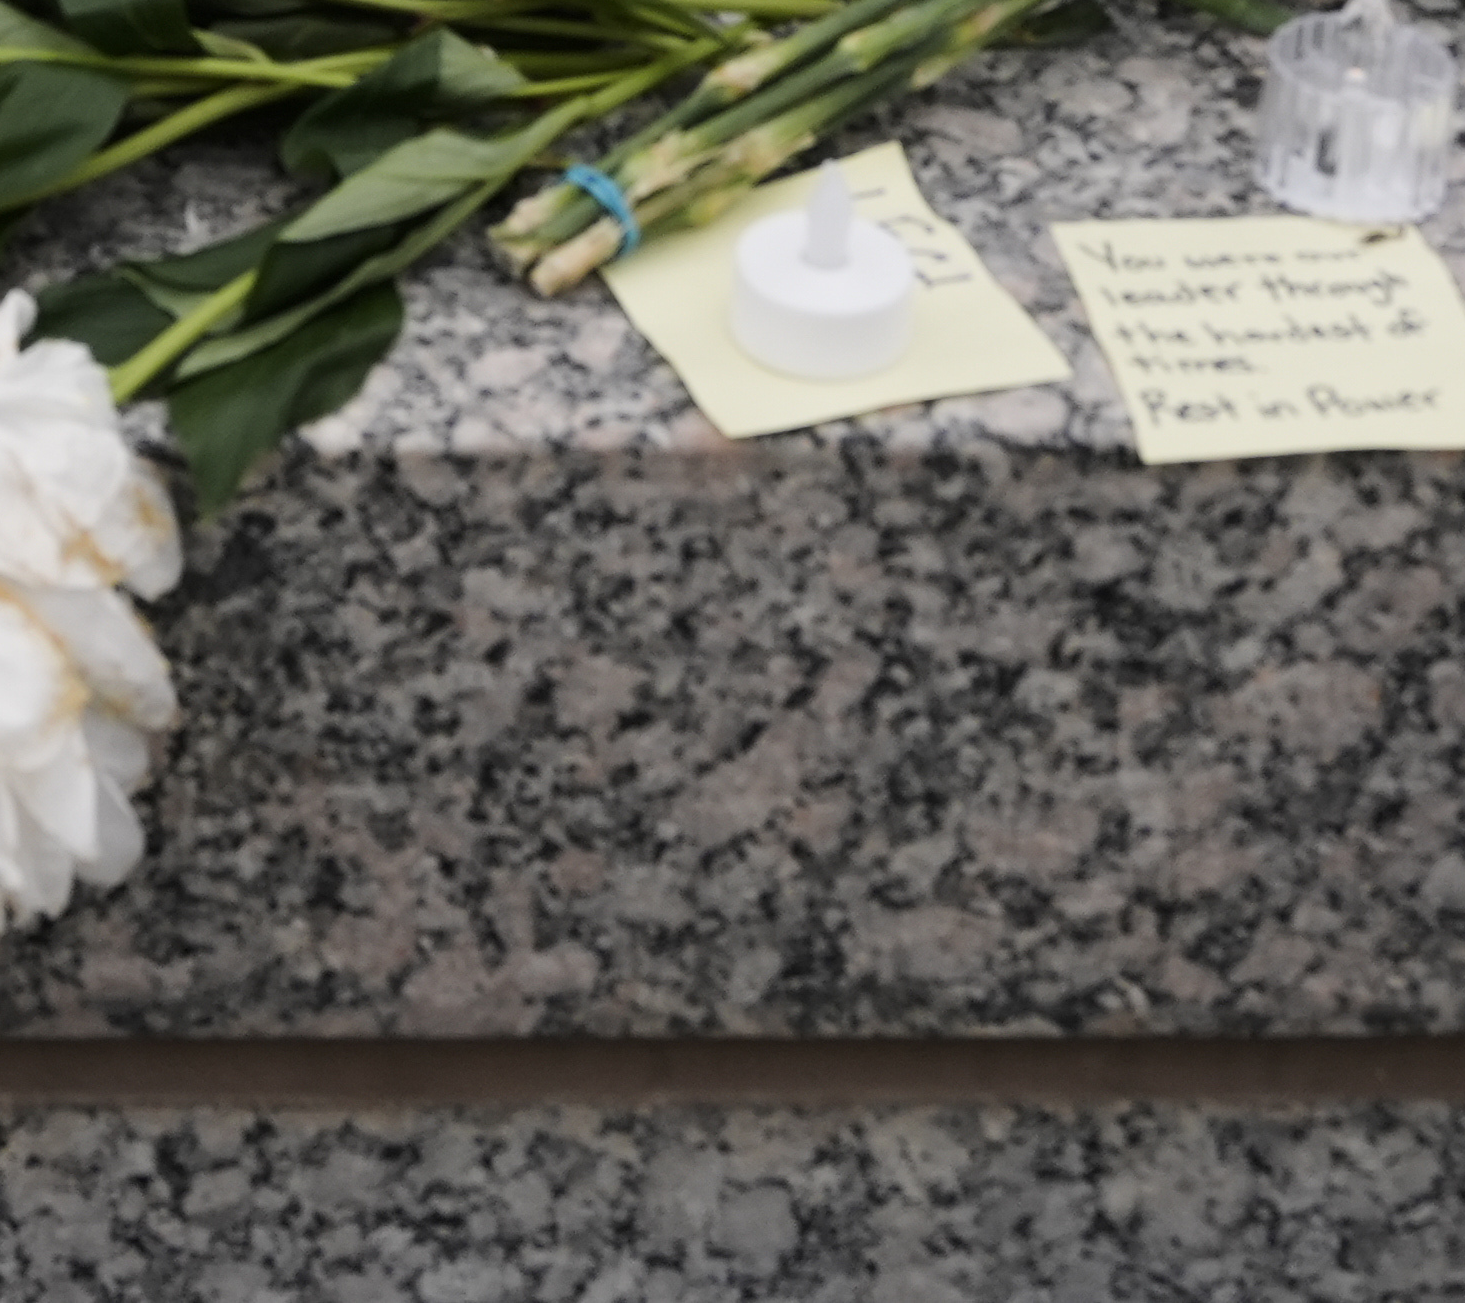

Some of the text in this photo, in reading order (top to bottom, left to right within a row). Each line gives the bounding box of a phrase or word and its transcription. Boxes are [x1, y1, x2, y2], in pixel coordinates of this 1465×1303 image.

[1077, 240, 1165, 273] You
[1115, 323, 1193, 345] the
[1139, 388, 1239, 427] Rest
[1307, 384, 1438, 417] Power
